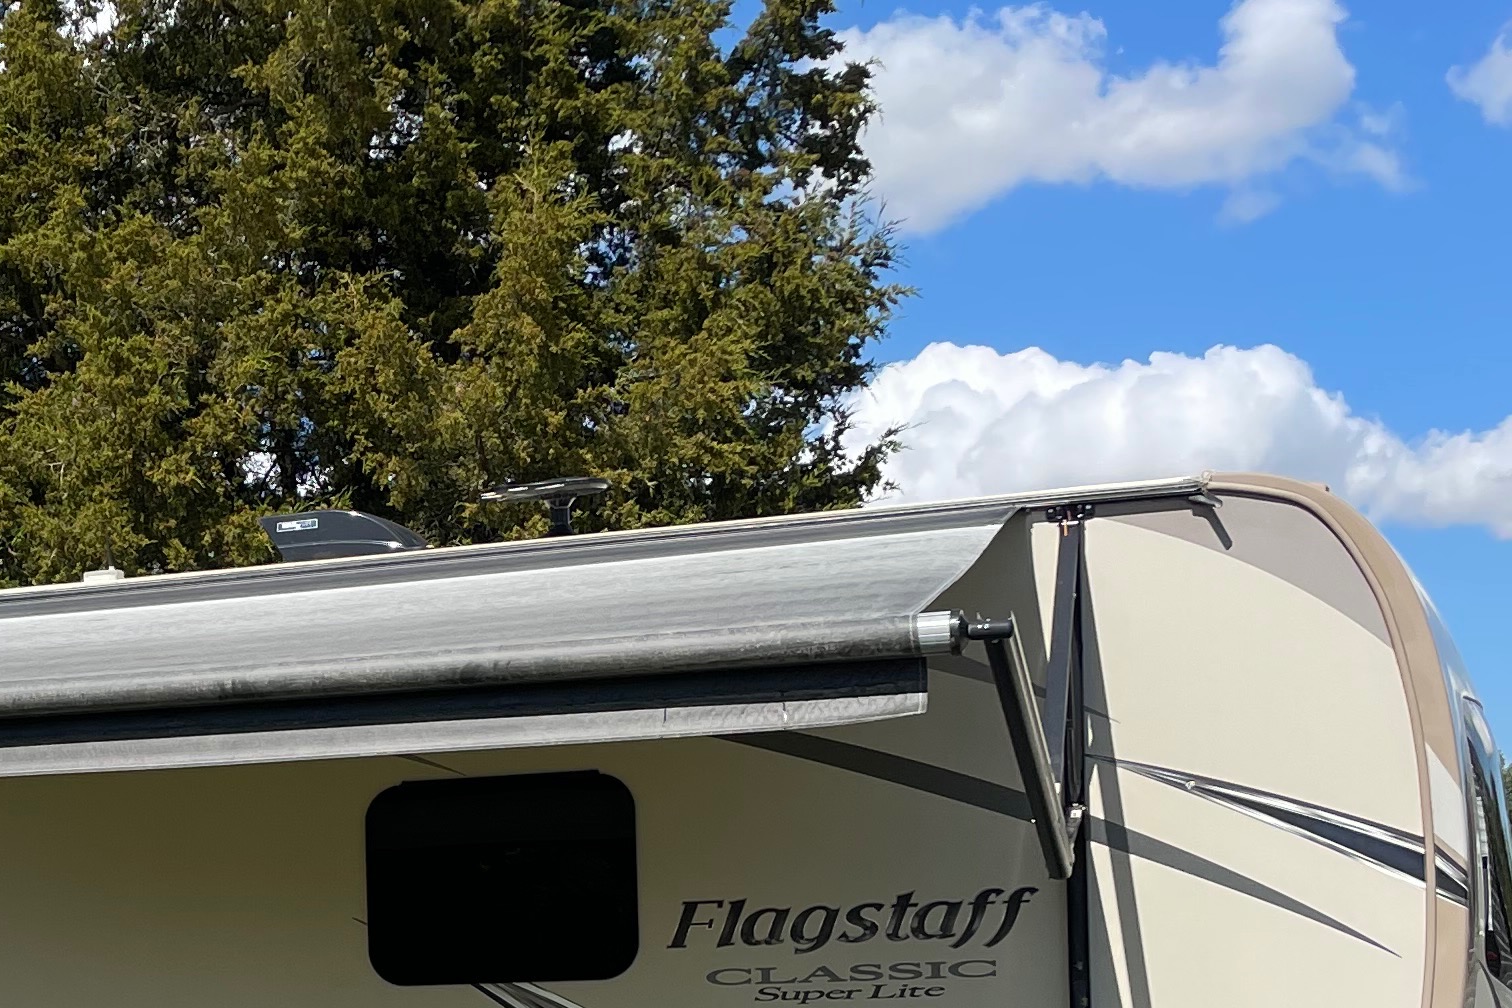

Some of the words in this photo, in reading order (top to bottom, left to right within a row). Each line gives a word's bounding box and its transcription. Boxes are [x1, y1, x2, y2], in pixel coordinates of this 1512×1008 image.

[666, 886, 1039, 955] Flagstaff
[706, 960, 997, 986] CLASSIC
[754, 985, 862, 1005] Super
[866, 984, 946, 1000] Lite
